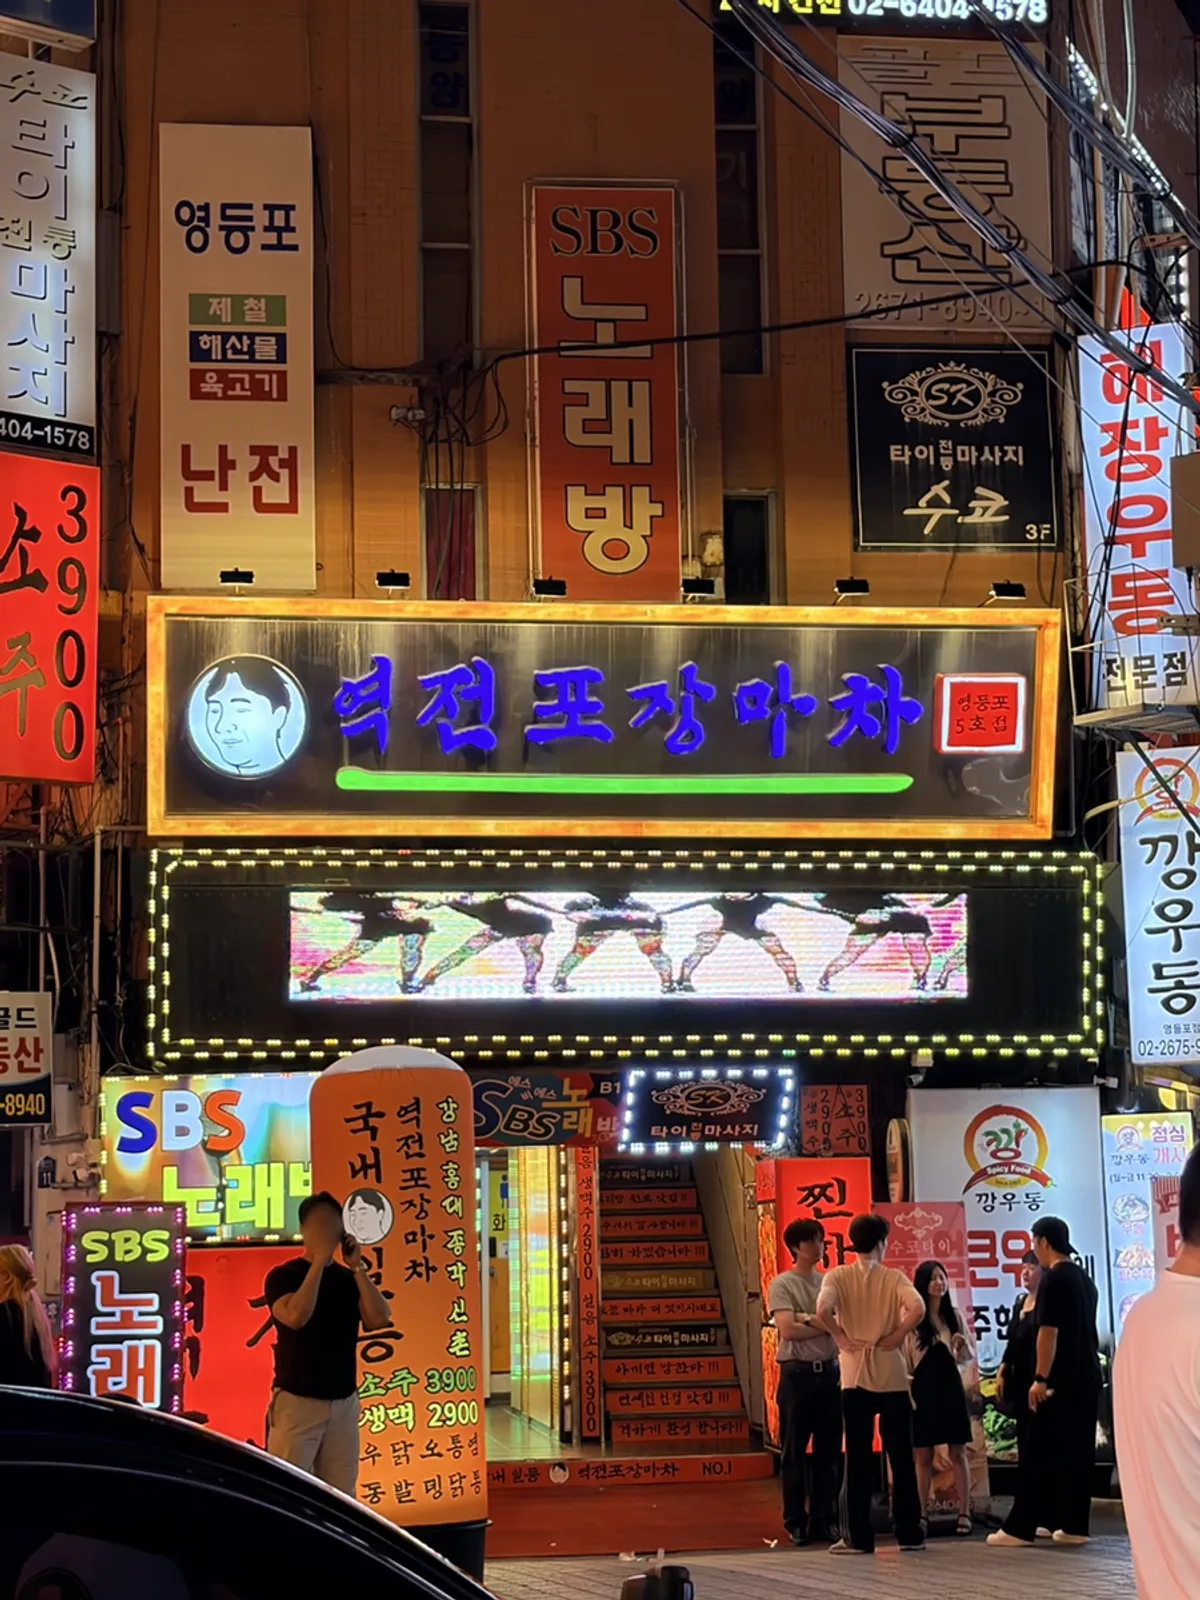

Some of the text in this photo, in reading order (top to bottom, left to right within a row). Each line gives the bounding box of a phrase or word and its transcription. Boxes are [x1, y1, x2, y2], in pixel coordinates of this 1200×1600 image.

[174, 200, 299, 254] 영등포
[550, 205, 660, 258] SBS
[208, 297, 267, 323] 제철
[199, 334, 279, 360] 해산물
[199, 372, 279, 397] 육고기
[557, 275, 665, 575] 노래방
[180, 443, 299, 515] 난전
[1099, 339, 1174, 637] 해장우동
[1025, 523, 1052, 541] 3F
[0, 501, 49, 737] 소주
[53, 484, 88, 762] 3900
[1102, 650, 1188, 693] 전문점
[333, 654, 925, 757] 역전포장마차
[957, 693, 1010, 712] 영등포
[1138, 829, 1200, 1015] 깡우동
[116, 1089, 246, 1154] SBS
[343, 1100, 387, 1184] 국내
[396, 1096, 438, 1284] 역전포장마차
[974, 1191, 1047, 1213] 깡우동
[81, 1229, 170, 1263] SBS
[436, 1095, 471, 1358] 강남 홍대 종각 신촌
[357, 1365, 477, 1400] 소주 3900
[426, 1400, 479, 1429] 2900
